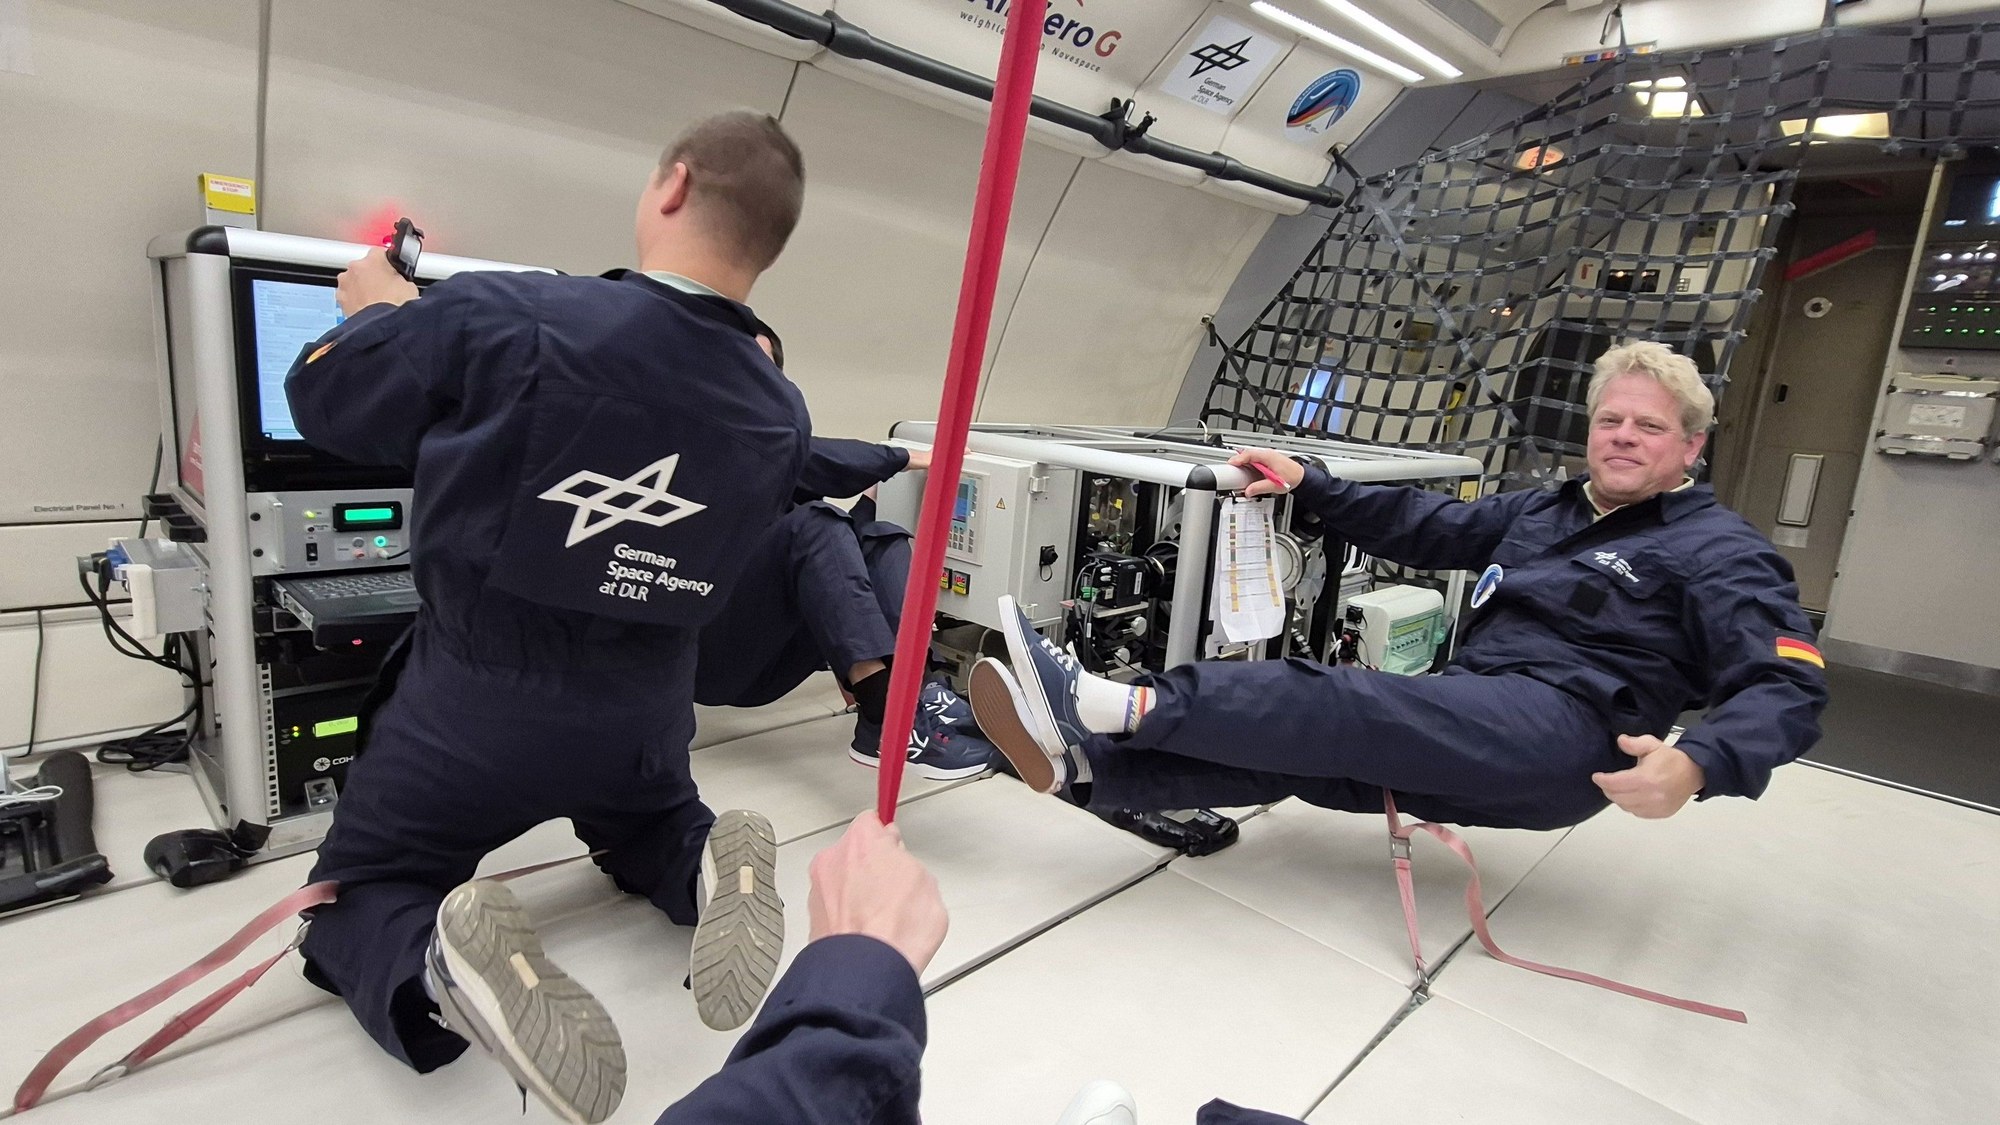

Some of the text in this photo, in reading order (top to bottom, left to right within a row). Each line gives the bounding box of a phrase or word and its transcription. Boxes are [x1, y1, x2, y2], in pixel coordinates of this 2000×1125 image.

[1051, 46, 1101, 73] Novespace
[1203, 77, 1227, 91] German
[1197, 85, 1234, 106] Space Agency
[33, 505, 74, 513] Electrical
[76, 503, 101, 511] Panel
[613, 543, 677, 570] German
[605, 560, 714, 597] Space Agency
[598, 581, 649, 602] at DLR
